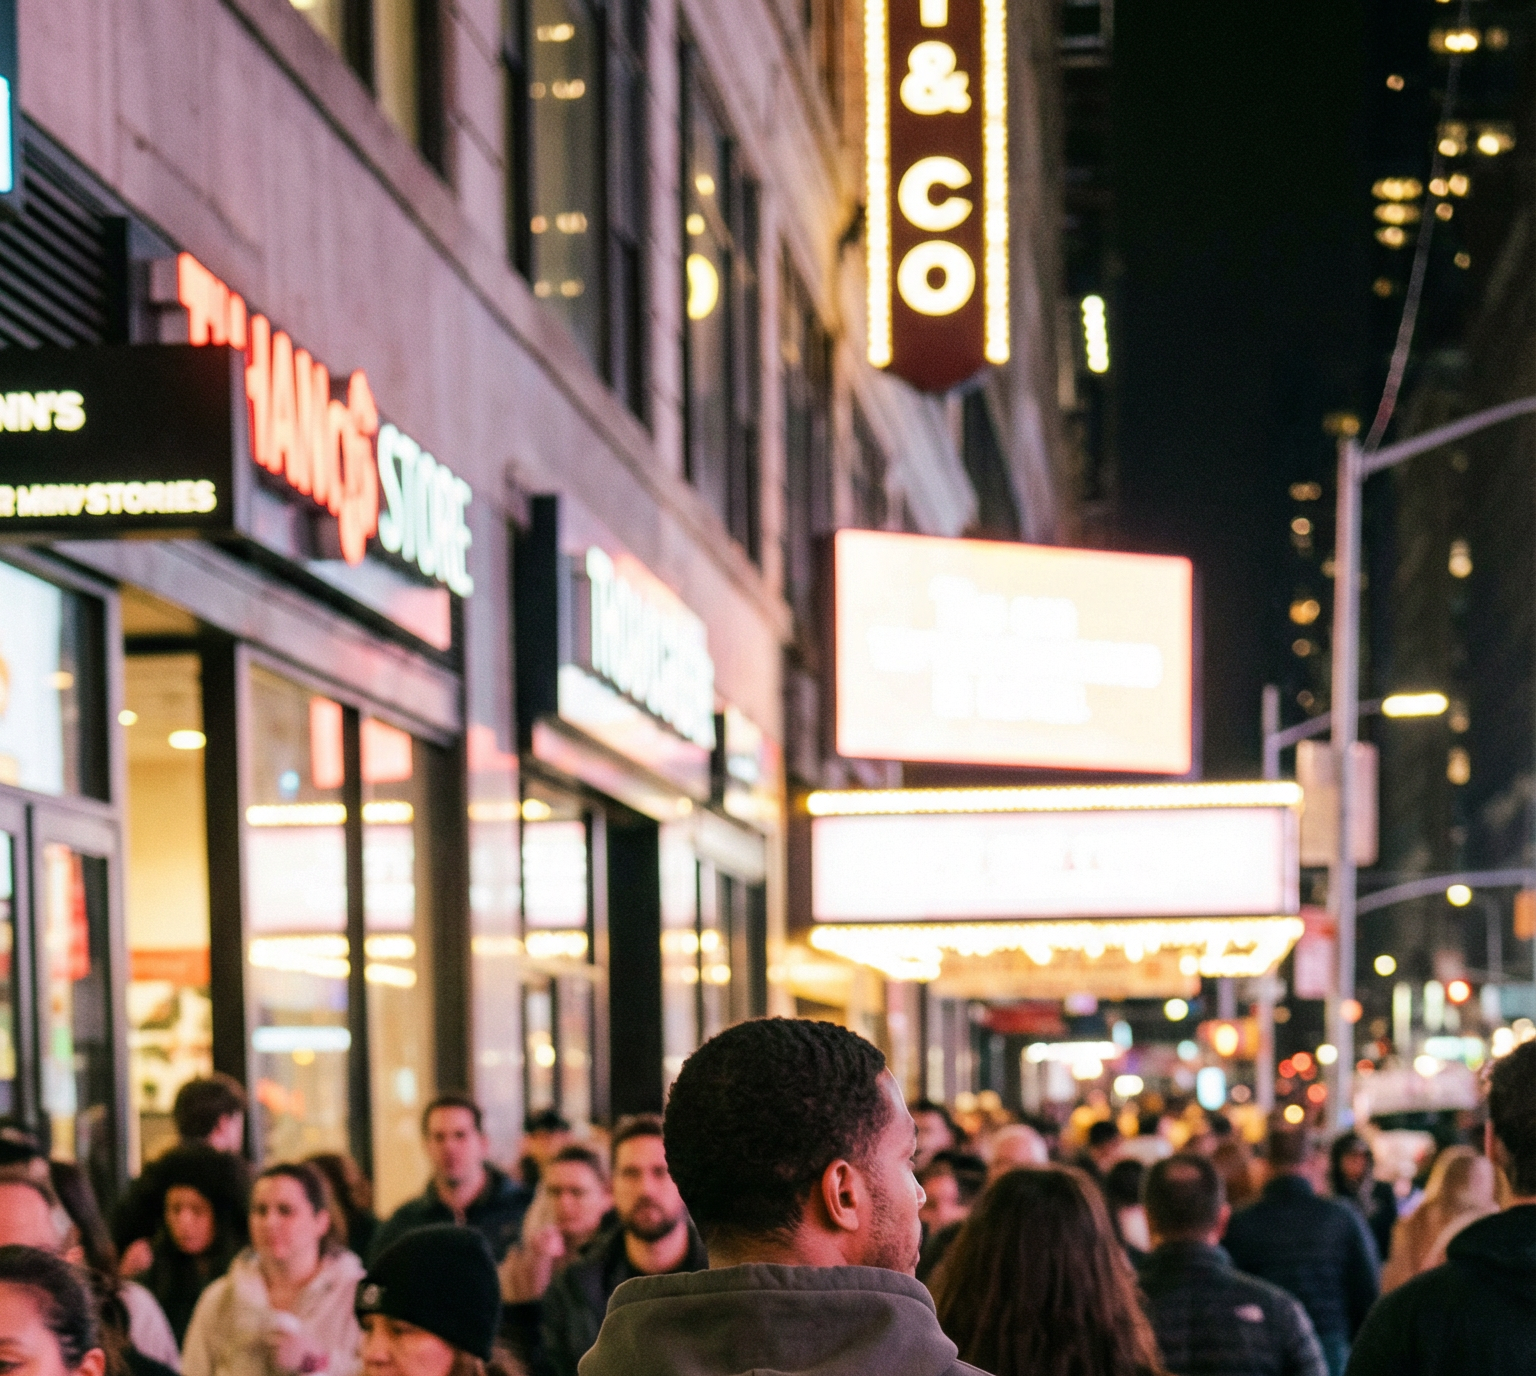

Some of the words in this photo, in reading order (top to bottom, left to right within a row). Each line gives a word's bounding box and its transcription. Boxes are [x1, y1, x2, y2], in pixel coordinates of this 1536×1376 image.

[900, 41, 971, 114] &
[898, 156, 975, 315] CO
[84, 480, 216, 514] STORIES
[378, 424, 474, 597] STORE
